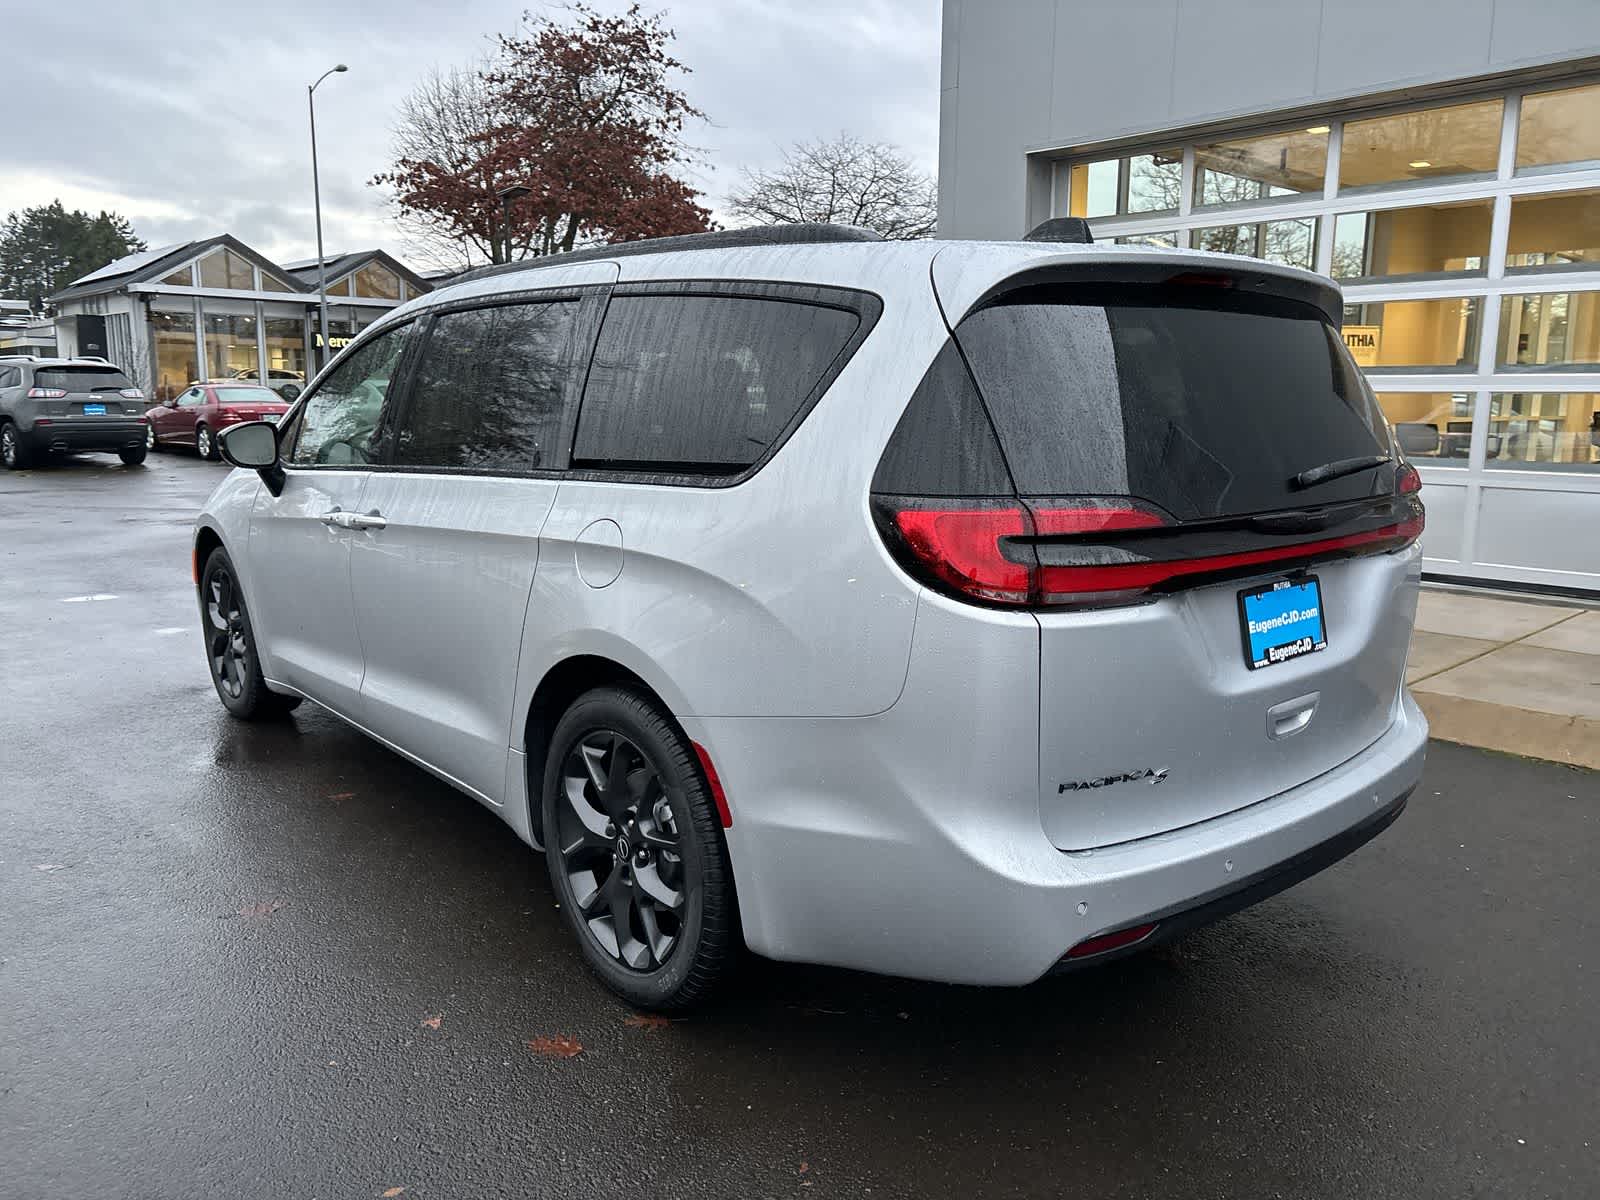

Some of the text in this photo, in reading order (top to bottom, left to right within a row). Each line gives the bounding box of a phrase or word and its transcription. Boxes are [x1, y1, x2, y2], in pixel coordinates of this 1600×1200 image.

[315, 333, 352, 347] Merc
[1248, 607, 1318, 634] EugeneCJD.com
[1058, 768, 1155, 794] PACIFICA
